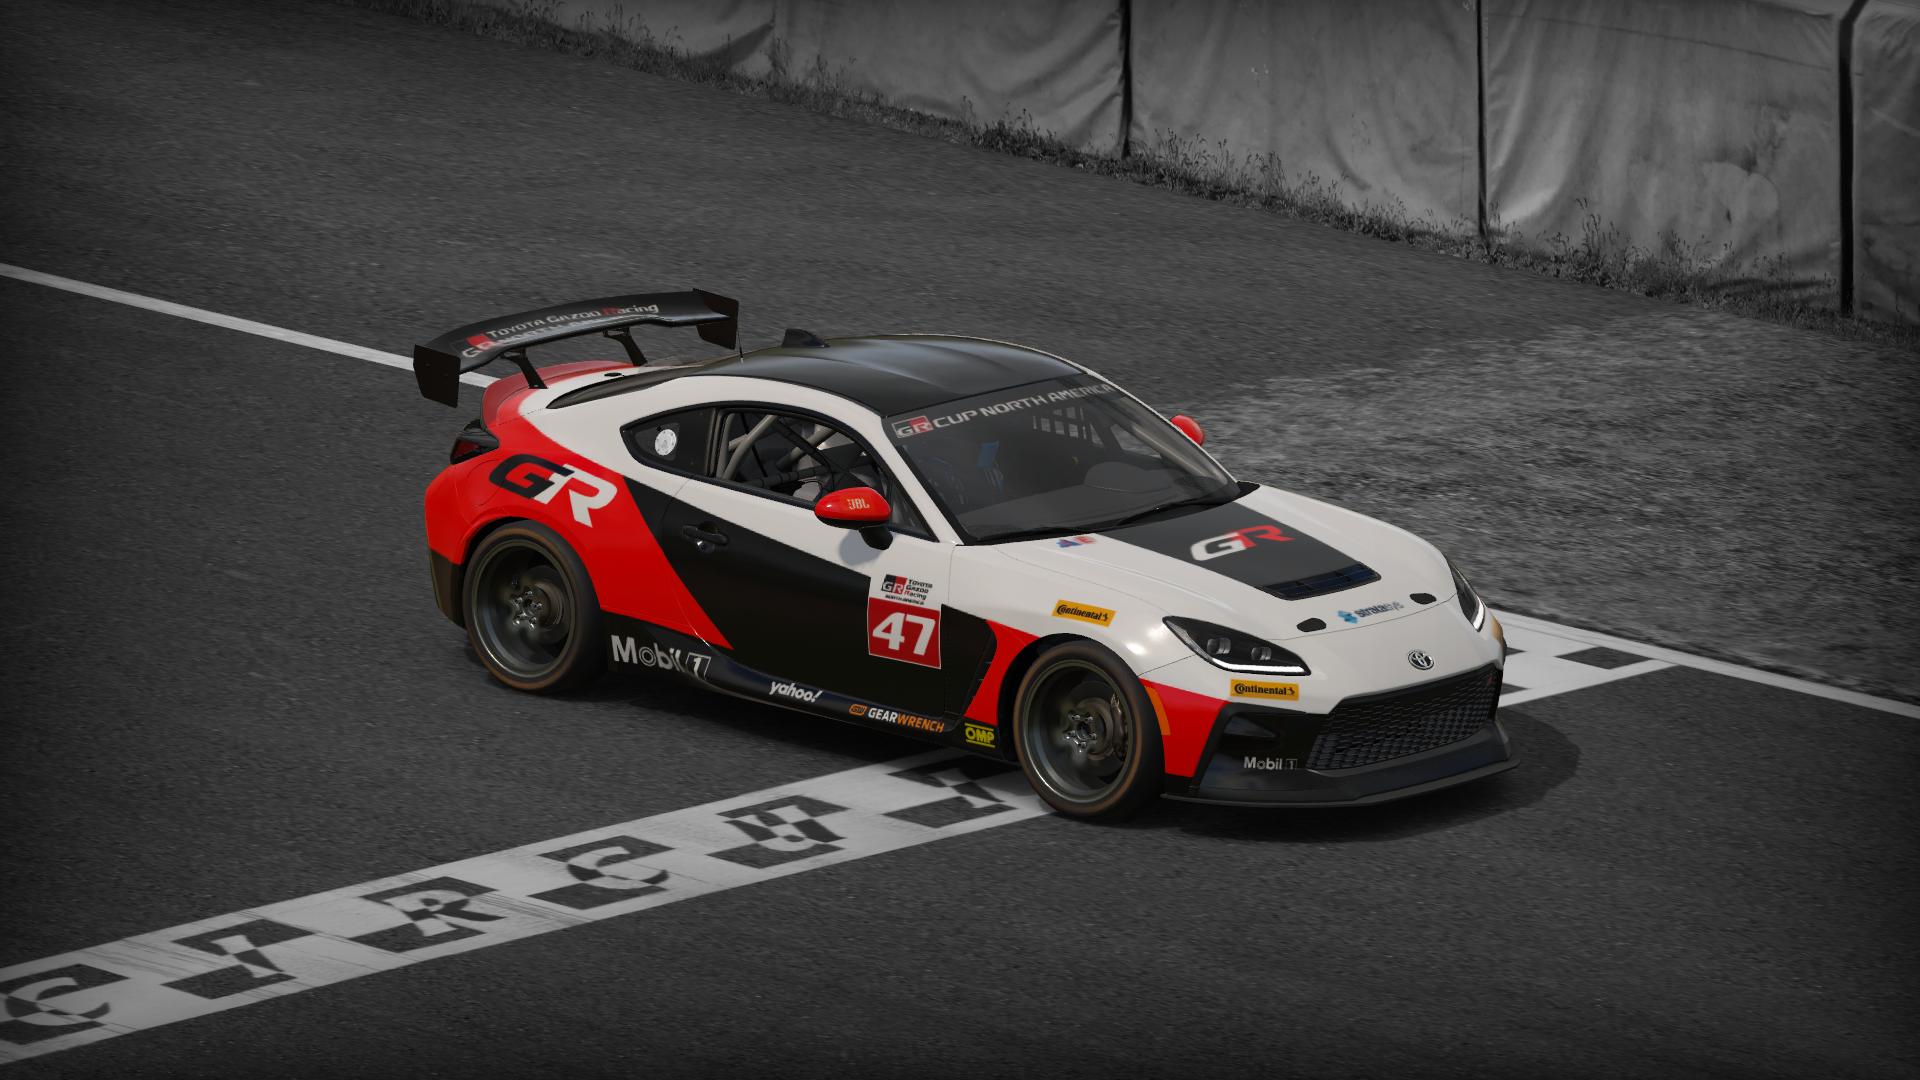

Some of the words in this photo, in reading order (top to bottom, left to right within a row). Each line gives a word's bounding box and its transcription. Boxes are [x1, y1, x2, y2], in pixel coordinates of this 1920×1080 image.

[486, 319, 546, 338] TOYOTA
[602, 304, 660, 315] Racing
[896, 421, 933, 437] GR
[932, 410, 977, 429] CUP
[980, 395, 1048, 417] NORTH
[1048, 383, 1116, 403] AMERICA
[489, 453, 618, 528] GR
[846, 498, 870, 510] JBL
[1190, 524, 1296, 562] GR
[881, 581, 905, 594] GR
[1056, 604, 1102, 620] Continental
[872, 611, 936, 656] 47
[610, 634, 684, 673] Mobil
[769, 680, 823, 703] yahoo!
[1234, 683, 1287, 695] Continental
[868, 707, 945, 733] GEARWRENCH
[964, 726, 995, 744] OMP
[1243, 756, 1283, 770] Mobil
